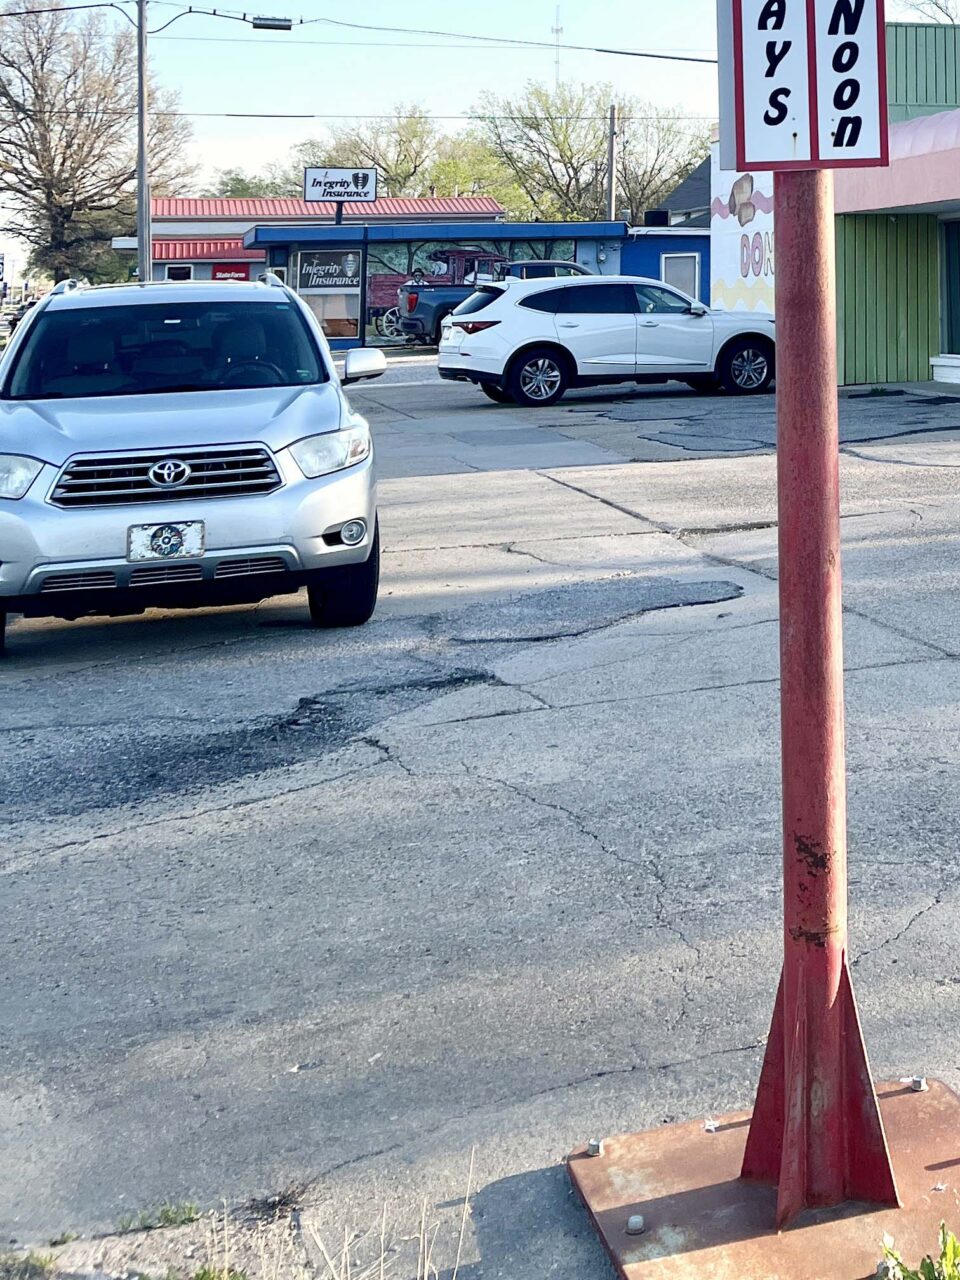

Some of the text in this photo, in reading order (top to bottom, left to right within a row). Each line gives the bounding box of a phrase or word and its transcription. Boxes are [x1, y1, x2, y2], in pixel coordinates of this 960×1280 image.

[320, 188, 371, 199] Insurance
[301, 257, 342, 276] Integrity
[310, 274, 360, 287] Insurance
